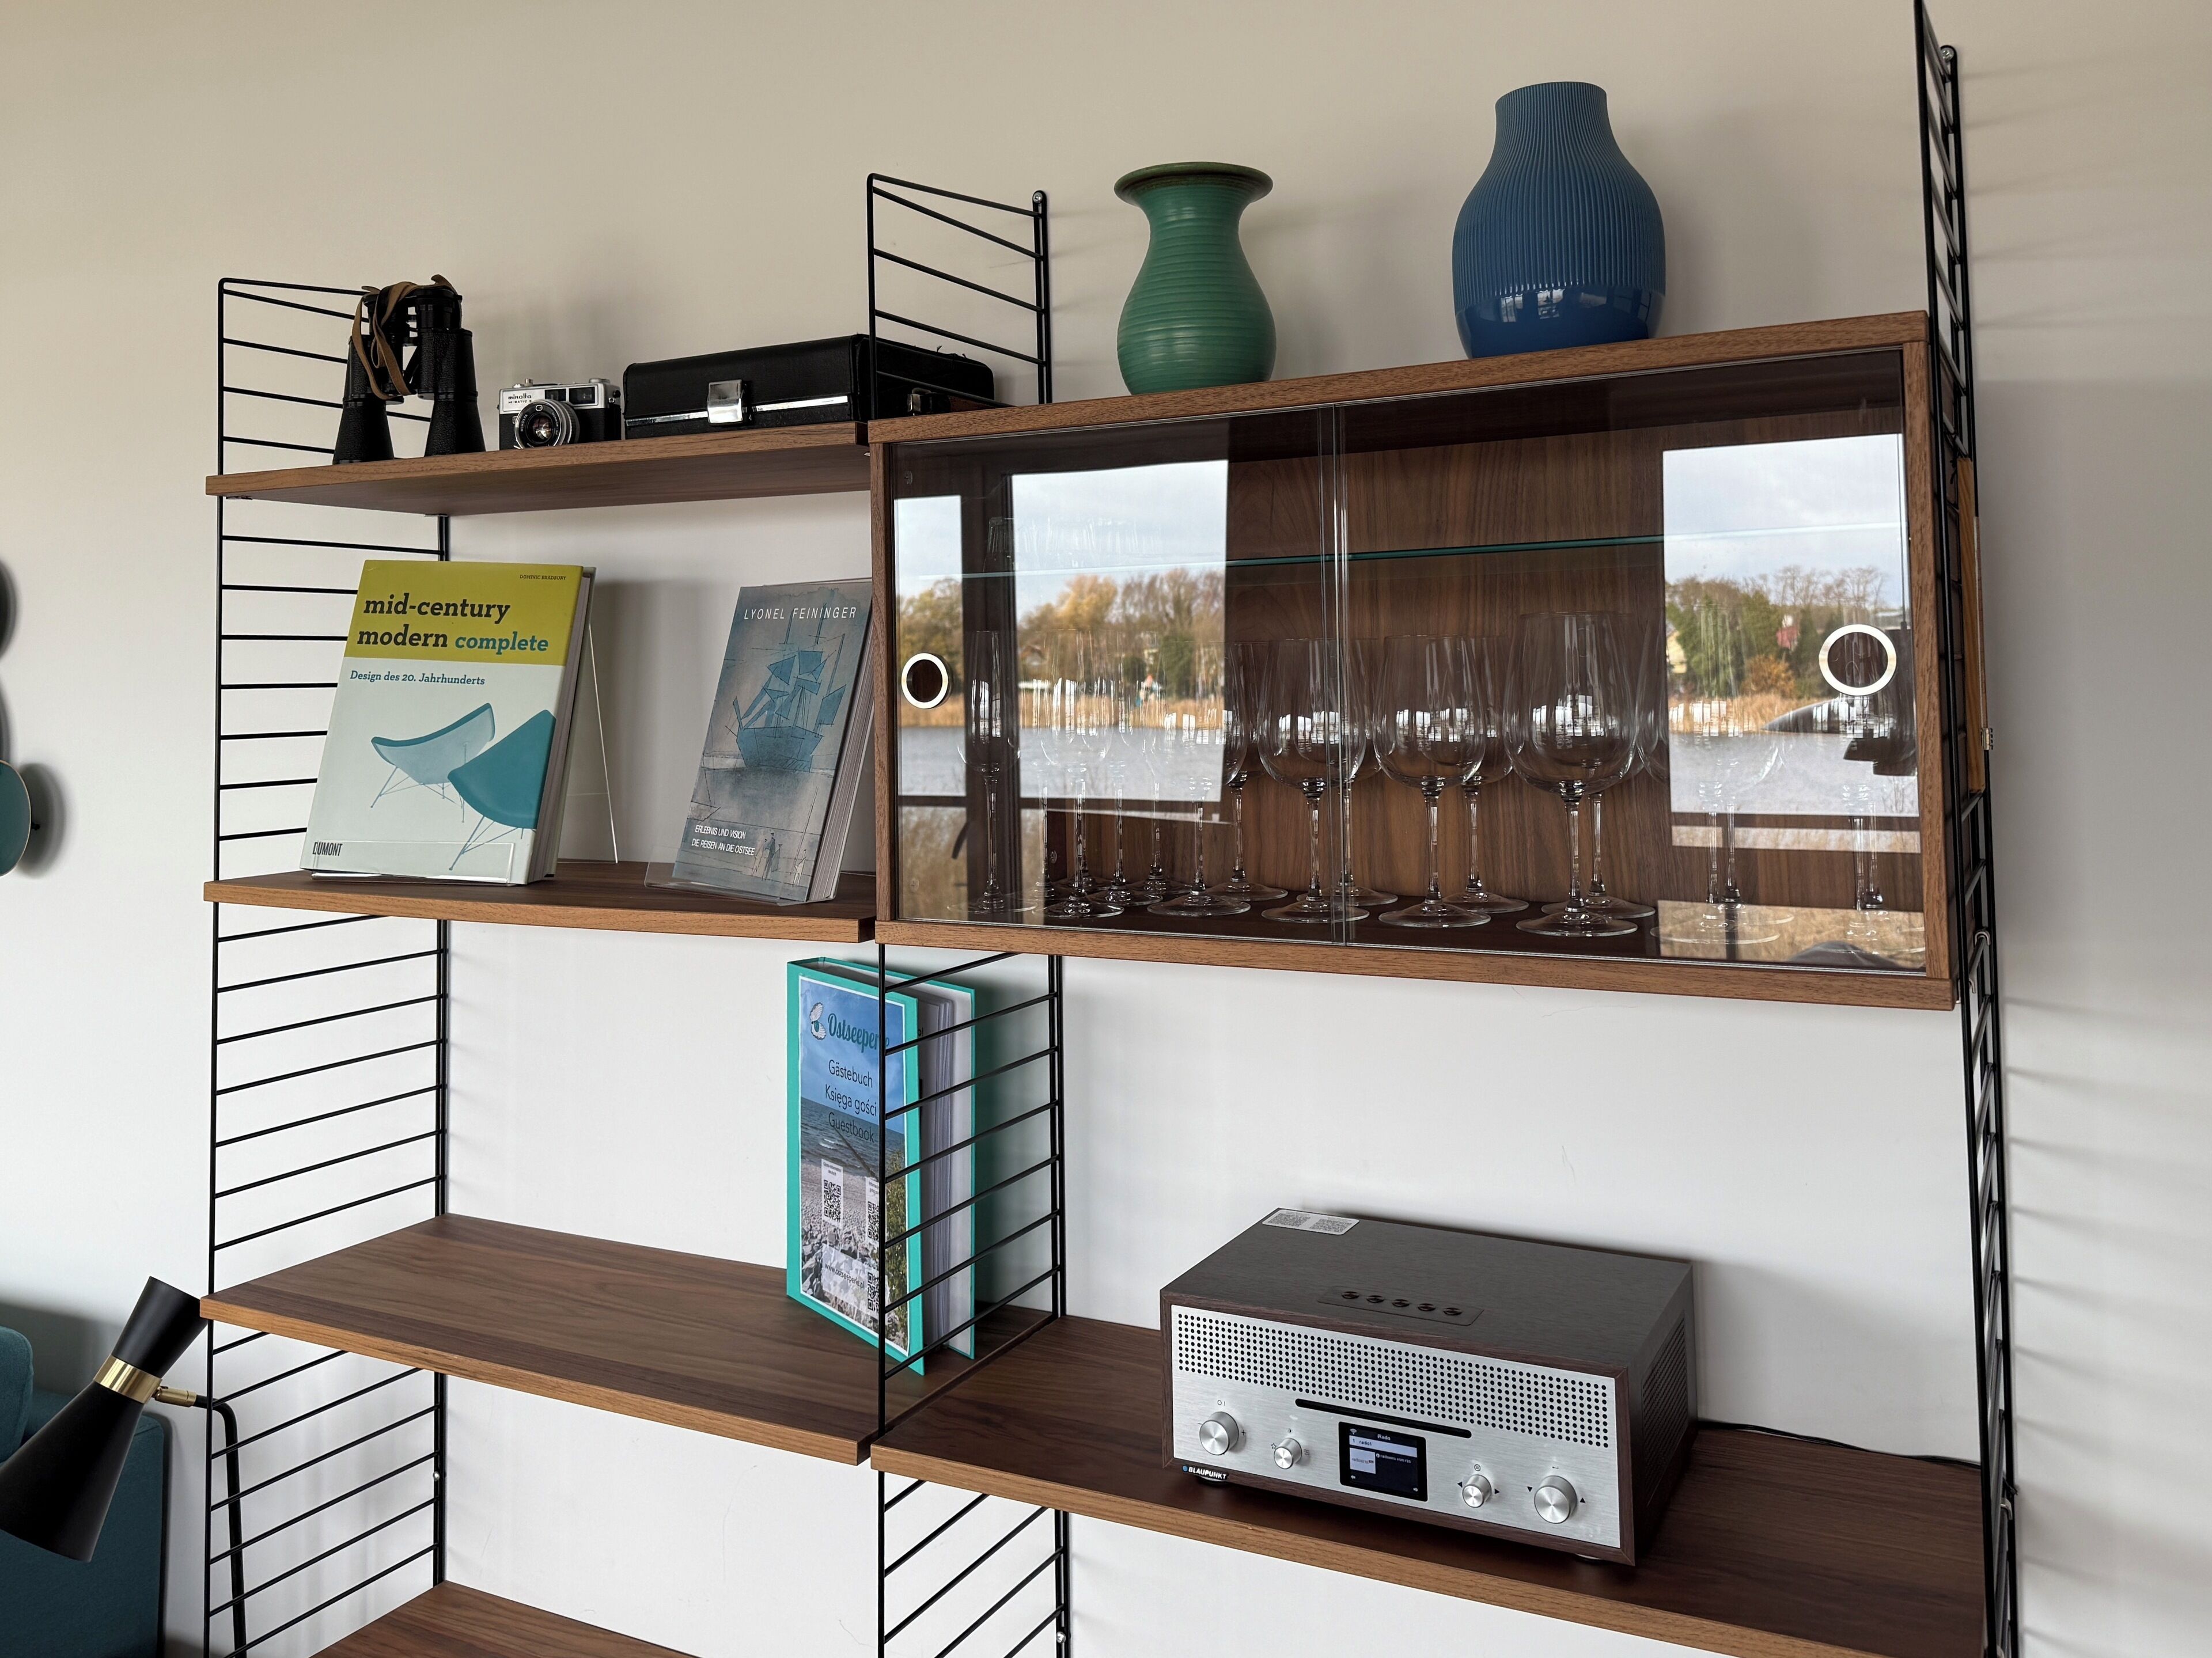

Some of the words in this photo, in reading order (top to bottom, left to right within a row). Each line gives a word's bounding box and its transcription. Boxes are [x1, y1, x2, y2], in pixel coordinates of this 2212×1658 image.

[363, 593, 510, 624] mid-century
[744, 608, 785, 620] LYONEL
[792, 607, 857, 619] FEININGER
[357, 624, 448, 647] modern
[454, 631, 548, 655] complete
[350, 670, 381, 682] Design
[384, 671, 400, 681] des
[419, 673, 485, 685] Jahrhunderts
[695, 825, 718, 836] ERLEBNIS
[718, 828, 729, 837] UND
[730, 830, 747, 839] VISION
[312, 841, 343, 856] DUMONT
[691, 839, 700, 847] DIE
[700, 840, 718, 849] REISEN
[718, 843, 726, 851] AN
[726, 844, 735, 852] DIE
[734, 845, 756, 855] OSTSEE
[828, 1059, 873, 1088] Gästebuch
[825, 1084, 852, 1110] Księga
[855, 1099, 877, 1117] gości
[828, 1112, 874, 1143] Guestbook
[1188, 1466, 1227, 1479] BLAUPUNKT
